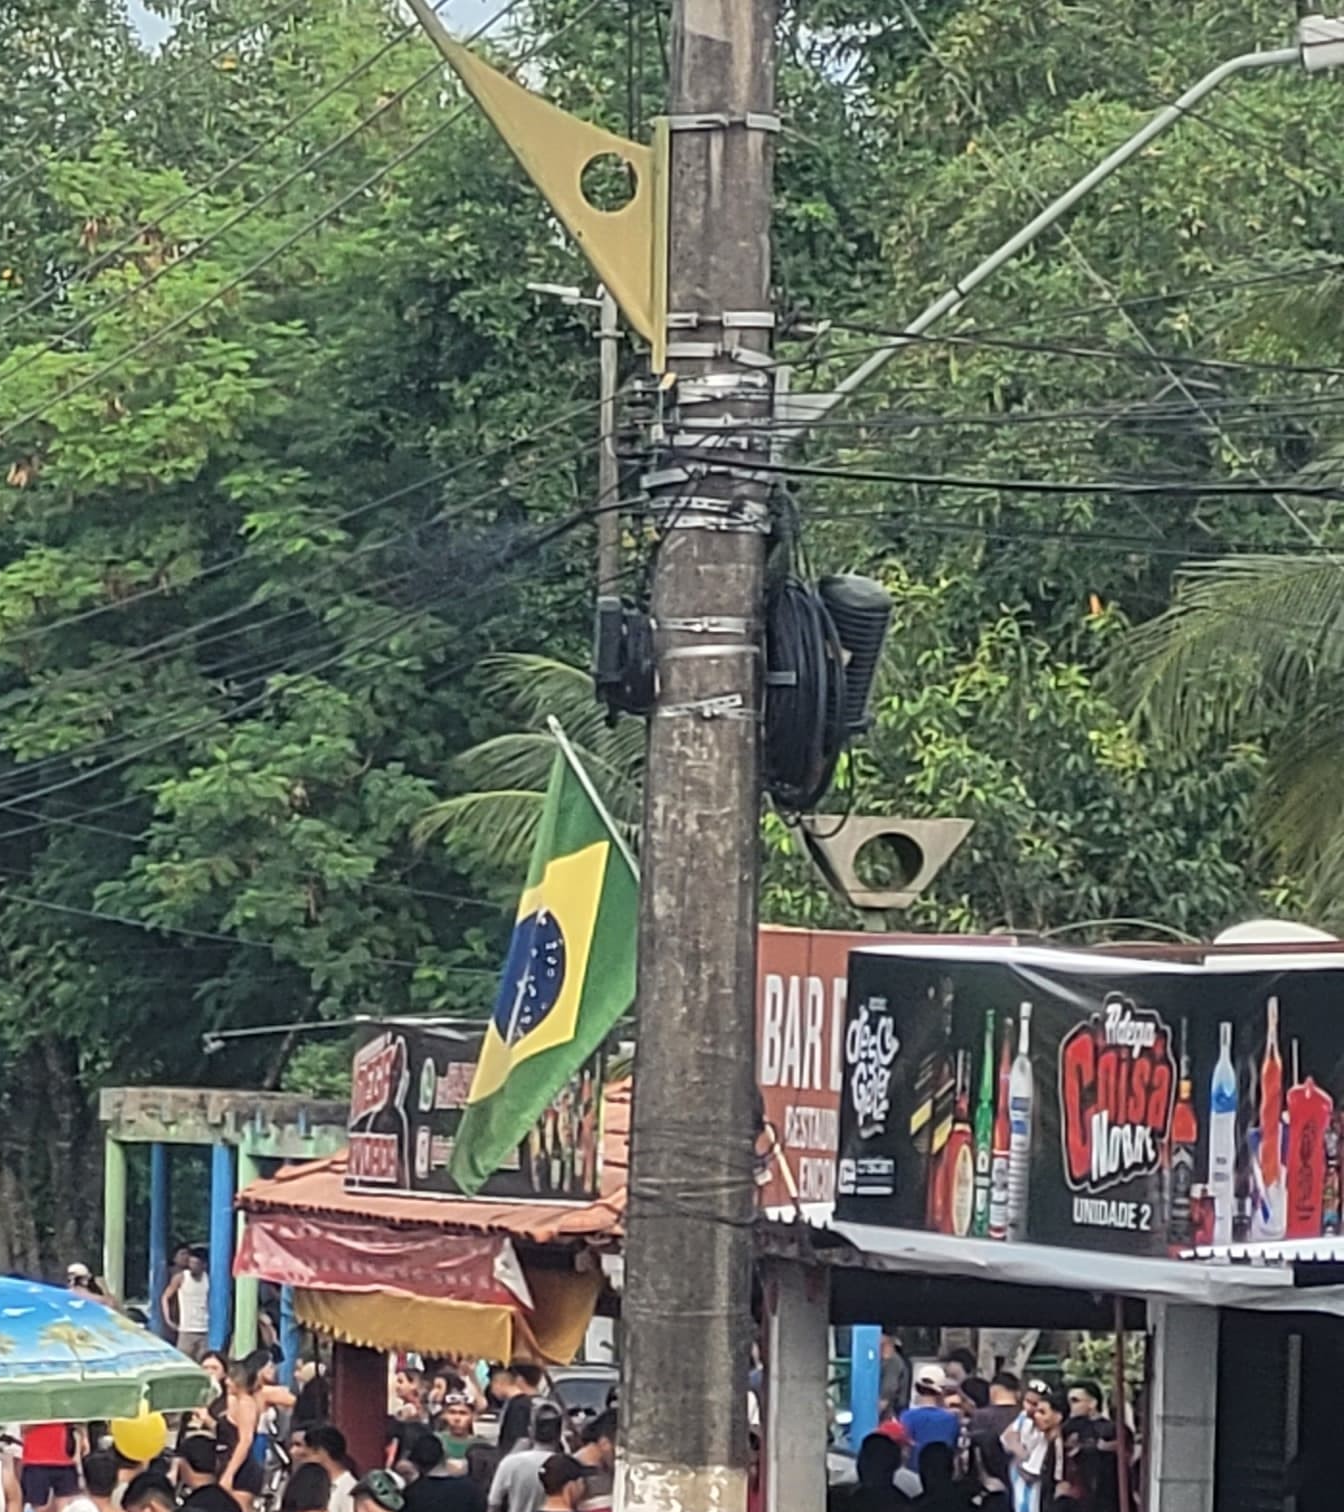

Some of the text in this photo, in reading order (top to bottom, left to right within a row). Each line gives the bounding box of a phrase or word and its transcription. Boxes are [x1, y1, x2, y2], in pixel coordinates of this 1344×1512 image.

[761, 974, 824, 1091] BAR
[1072, 1197, 1152, 1230] UNIDADE 2
